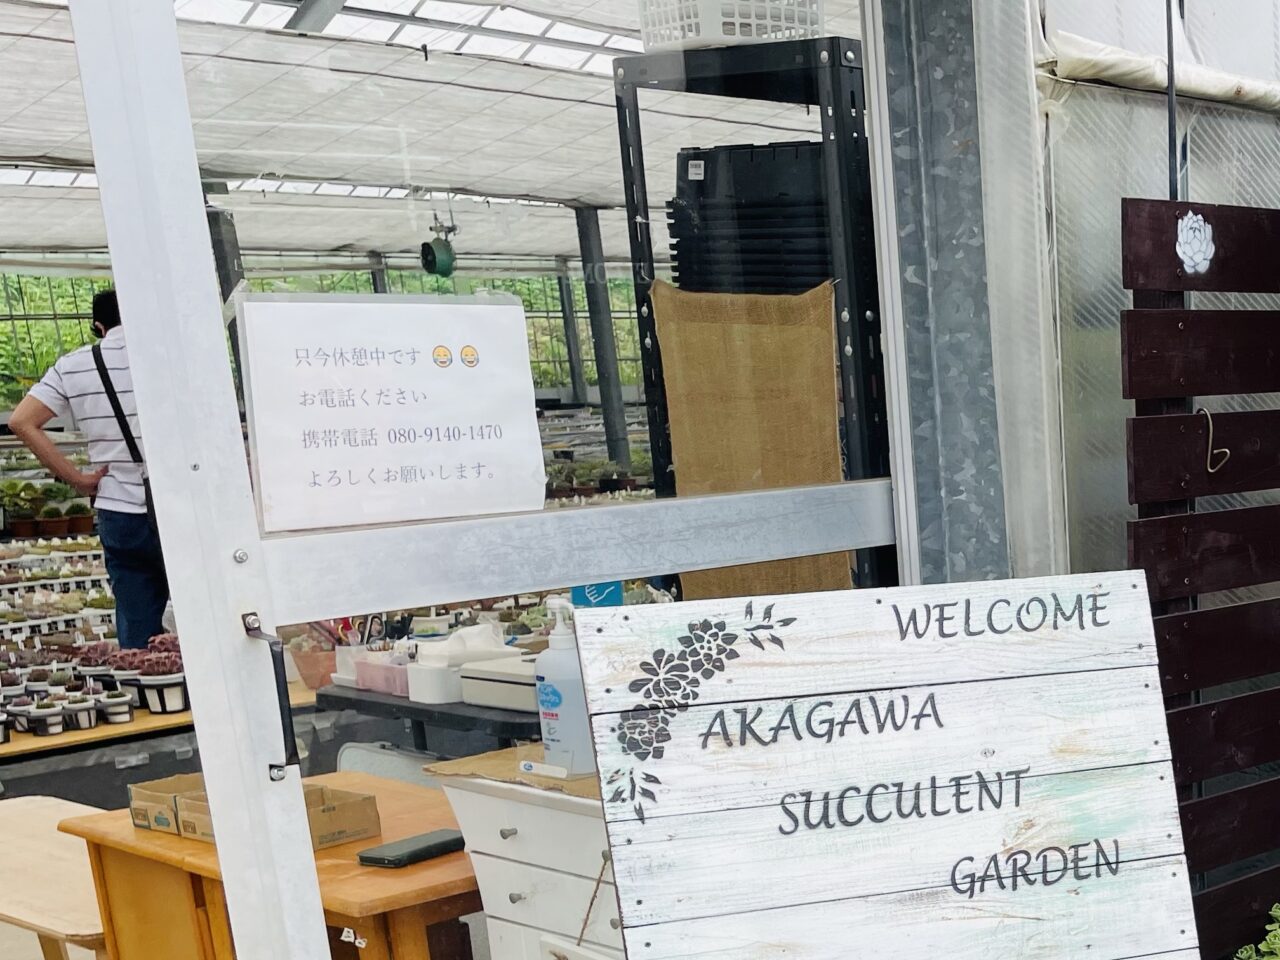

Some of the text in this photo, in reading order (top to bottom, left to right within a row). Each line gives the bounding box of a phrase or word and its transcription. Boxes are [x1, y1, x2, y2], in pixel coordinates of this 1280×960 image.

[295, 347, 421, 367] 只今休憩中です
[299, 387, 428, 408] お電話ください
[302, 424, 503, 450] 携帯電話 080-9140-1470
[892, 592, 1111, 641] WELCOME
[700, 692, 944, 749] AKAGAWA
[777, 766, 1031, 835] SUCCULENT
[949, 838, 1120, 898] GARDEN
